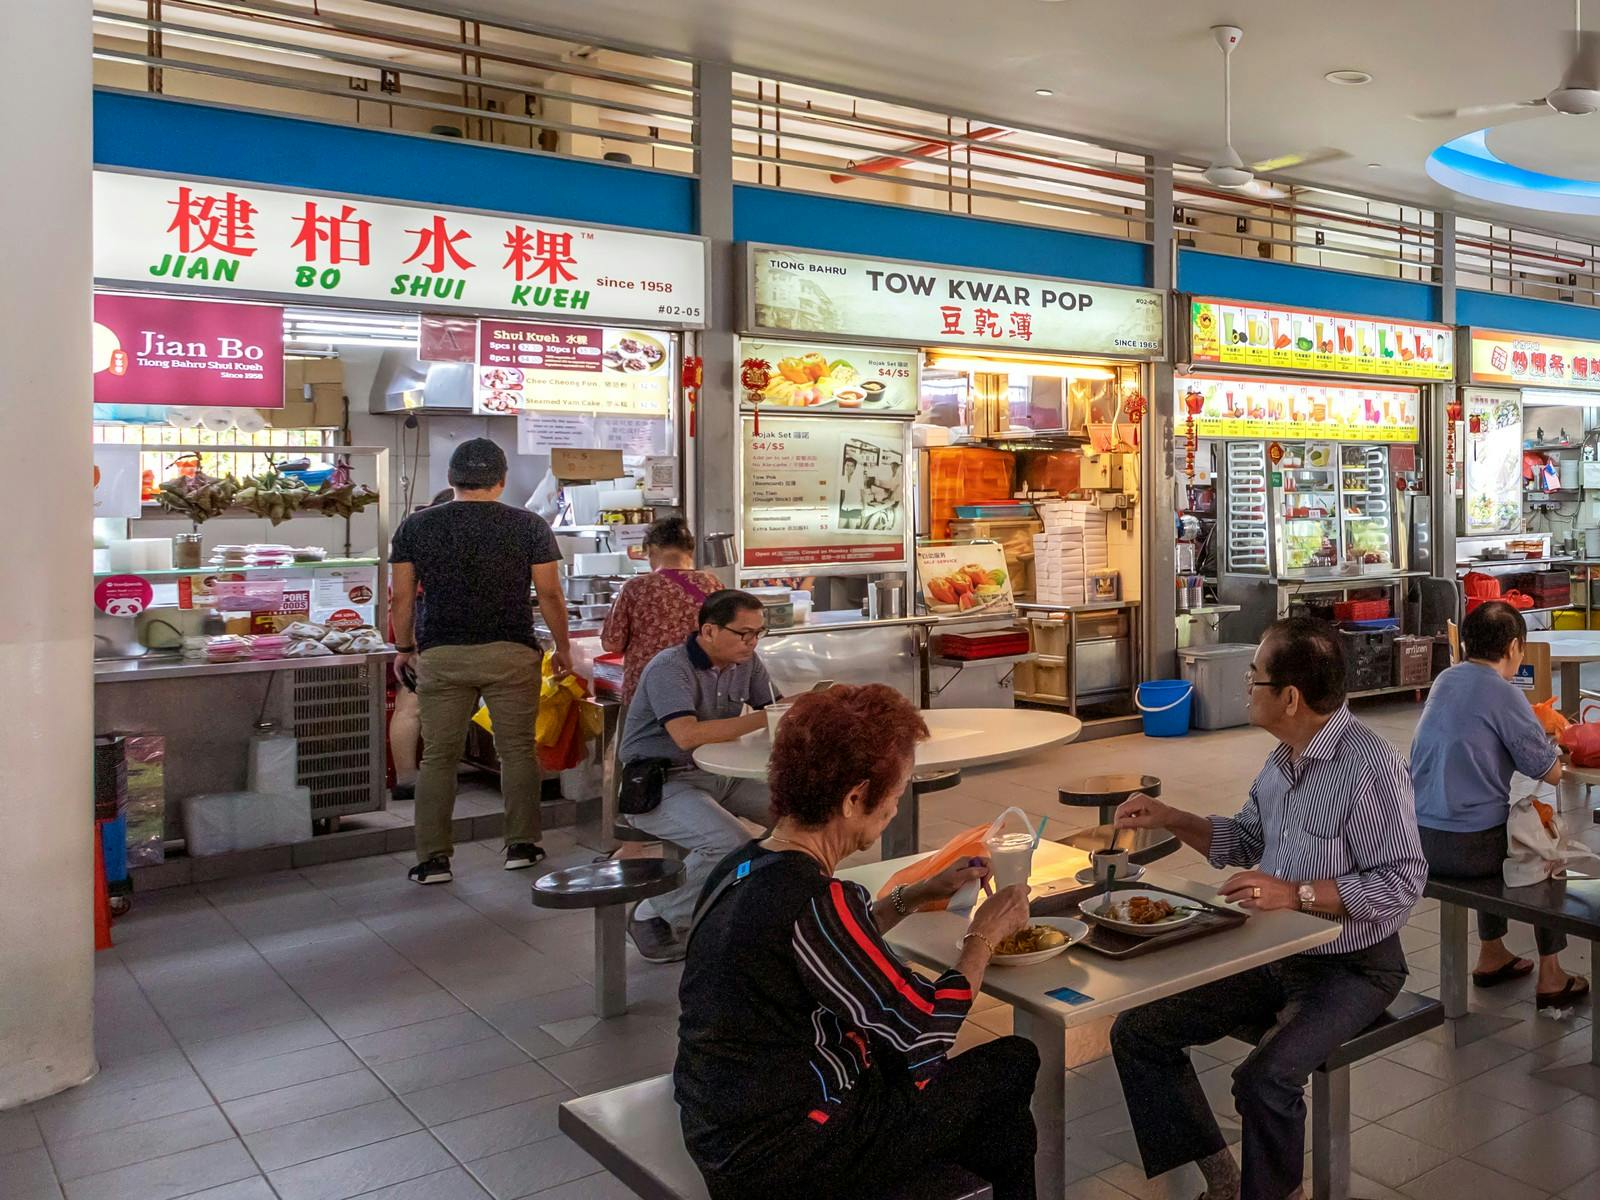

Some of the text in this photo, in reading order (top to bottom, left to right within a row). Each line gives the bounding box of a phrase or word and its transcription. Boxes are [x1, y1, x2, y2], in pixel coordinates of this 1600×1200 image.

[770, 259, 847, 276] TIONG BAHRU
[149, 254, 591, 310] JIAN BO SHUI KUEH
[596, 276, 673, 294] since 1958
[866, 269, 1093, 312] TOW KWAR POP
[657, 305, 700, 318] #02-05
[493, 330, 524, 340] Shui
[526, 332, 560, 343] Kueh
[1114, 338, 1137, 347] SINCE
[136, 330, 264, 360] Jian Bo
[545, 345, 571, 354] 10pcs
[137, 357, 263, 371] Tiong Bahru Shui Kueh
[220, 371, 243, 379] Since
[878, 368, 910, 378] $4/$5
[752, 442, 785, 450] $4/$5
[282, 593, 308, 602] PORE
